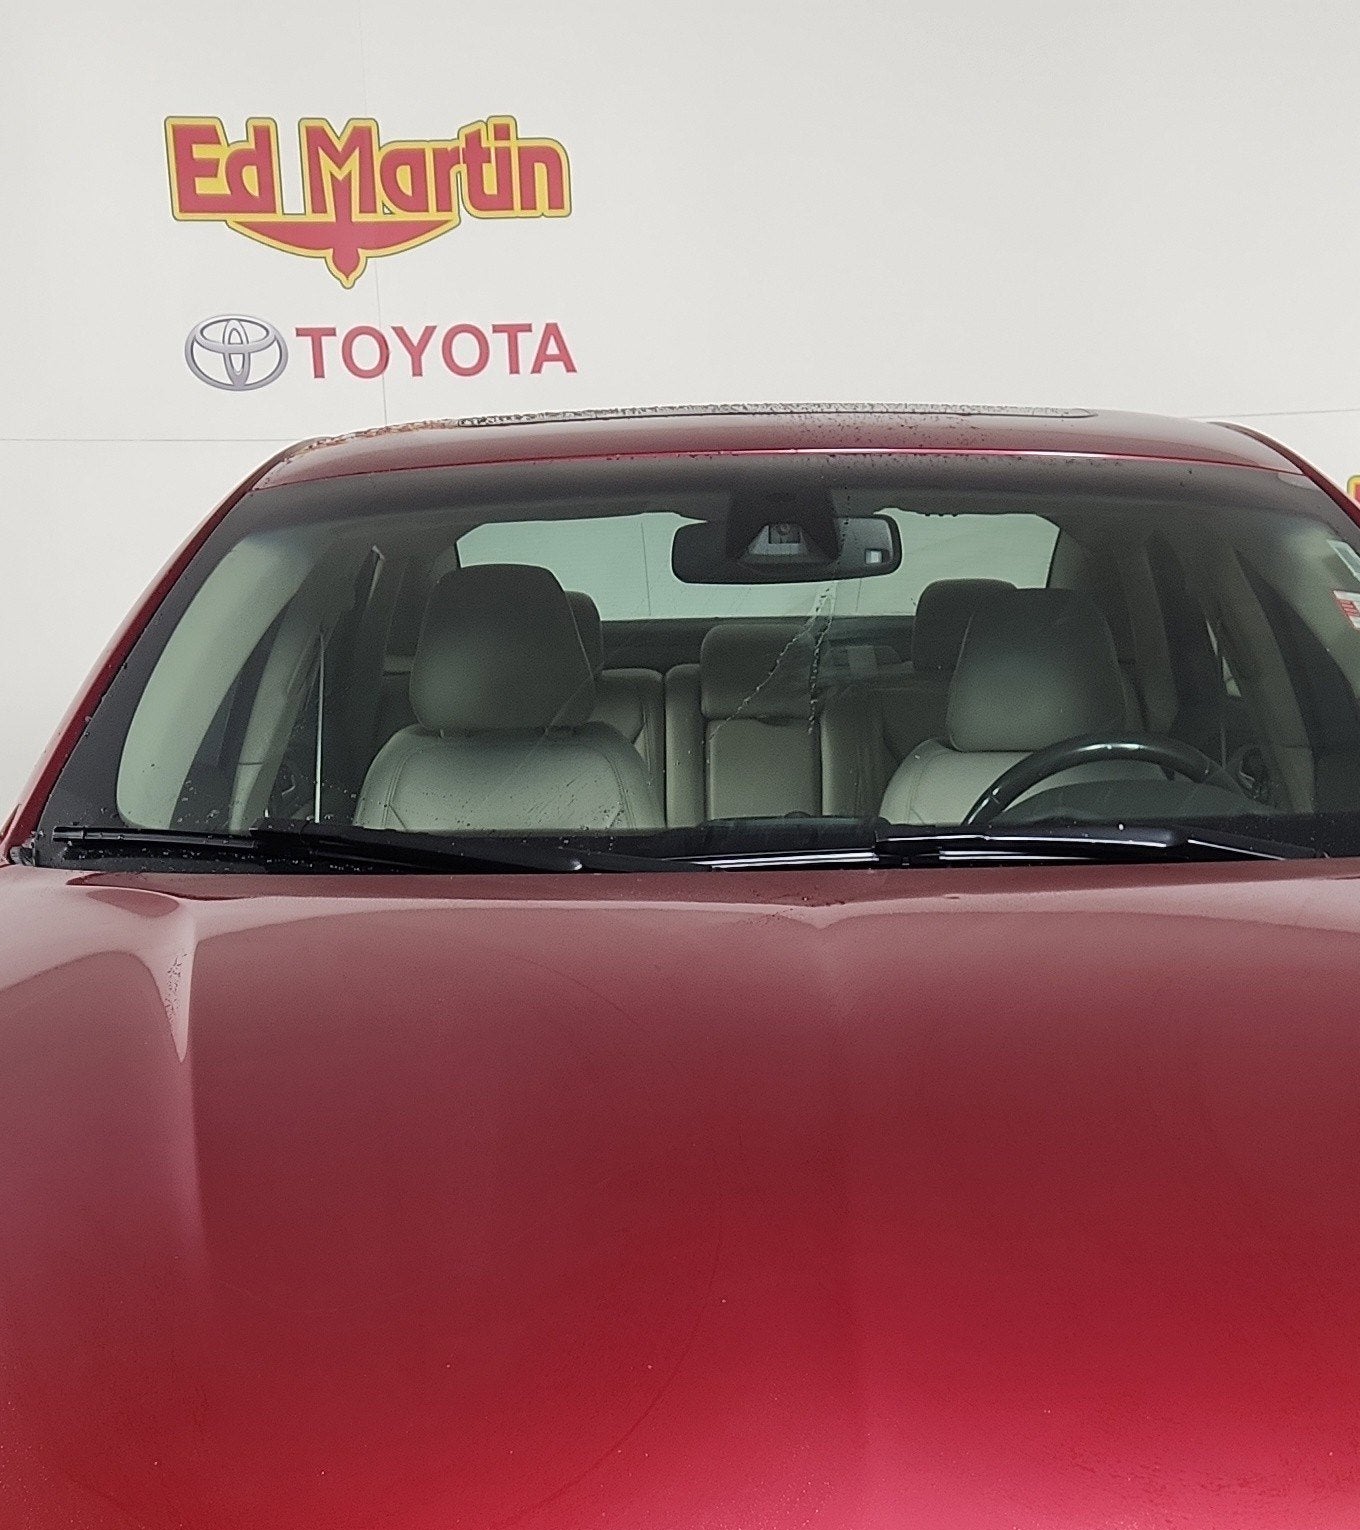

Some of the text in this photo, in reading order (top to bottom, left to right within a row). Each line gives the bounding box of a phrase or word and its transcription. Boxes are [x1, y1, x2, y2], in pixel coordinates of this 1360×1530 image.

[170, 119, 568, 217] Ed Martin
[295, 322, 578, 379] TOYOTA
